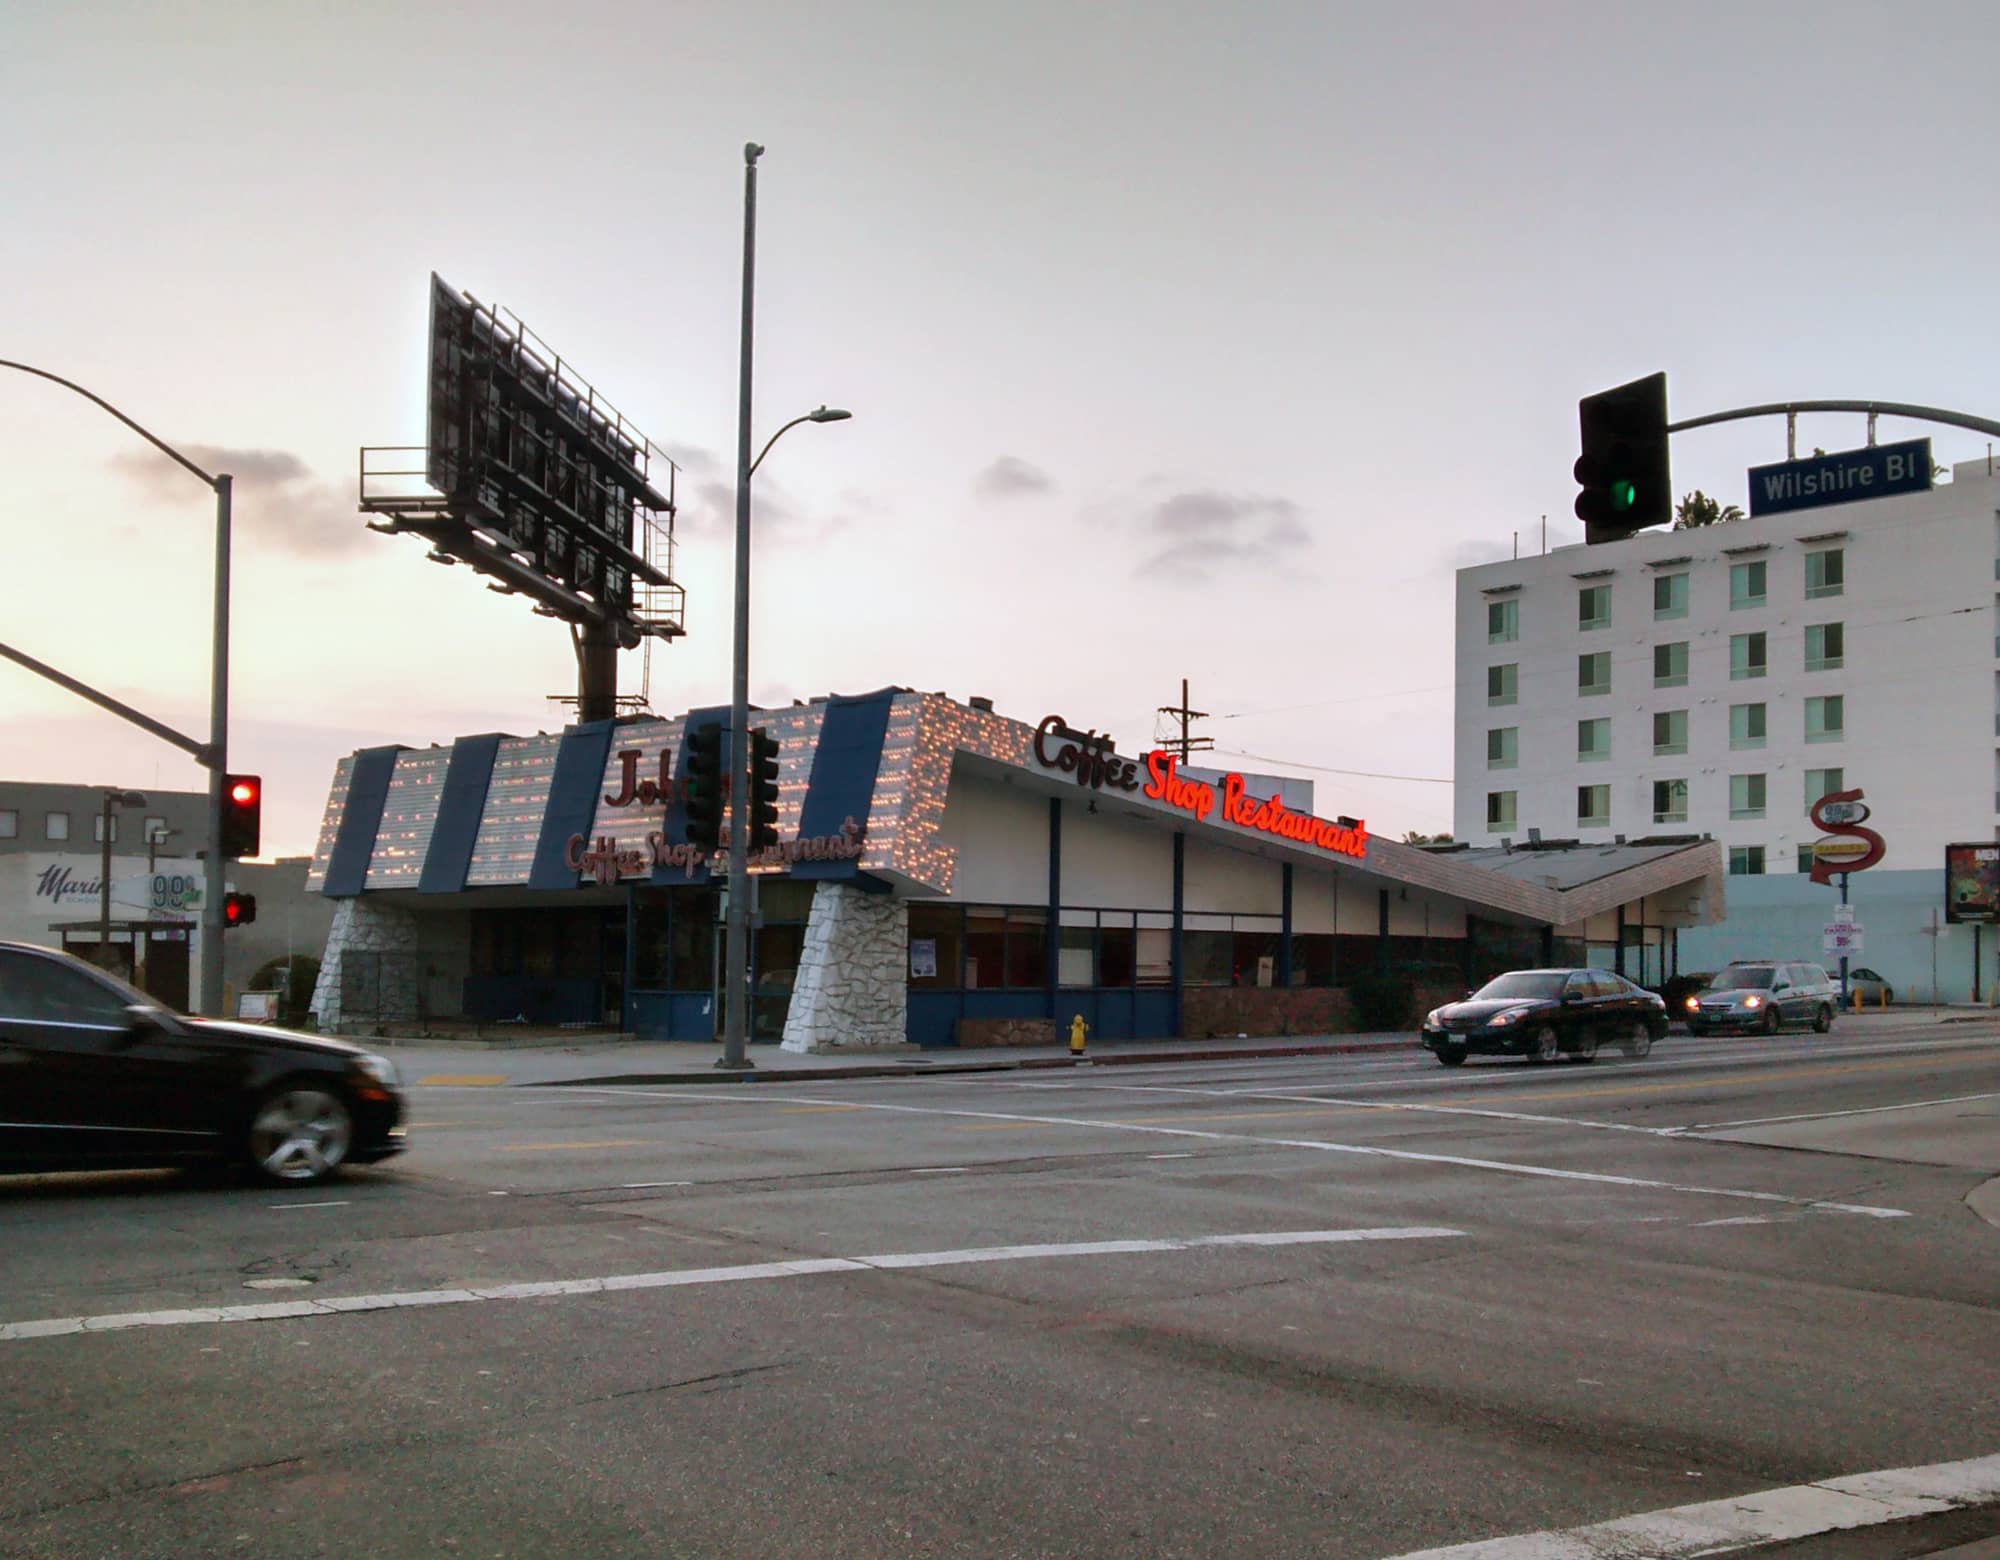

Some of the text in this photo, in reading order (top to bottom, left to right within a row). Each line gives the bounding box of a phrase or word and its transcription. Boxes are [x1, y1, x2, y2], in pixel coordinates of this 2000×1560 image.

[1764, 453, 1915, 501] Wilshire Bl
[1034, 715, 1369, 858] Coffee Shop Restaurant
[565, 833, 645, 885] Coffee
[645, 831, 706, 880] Shop
